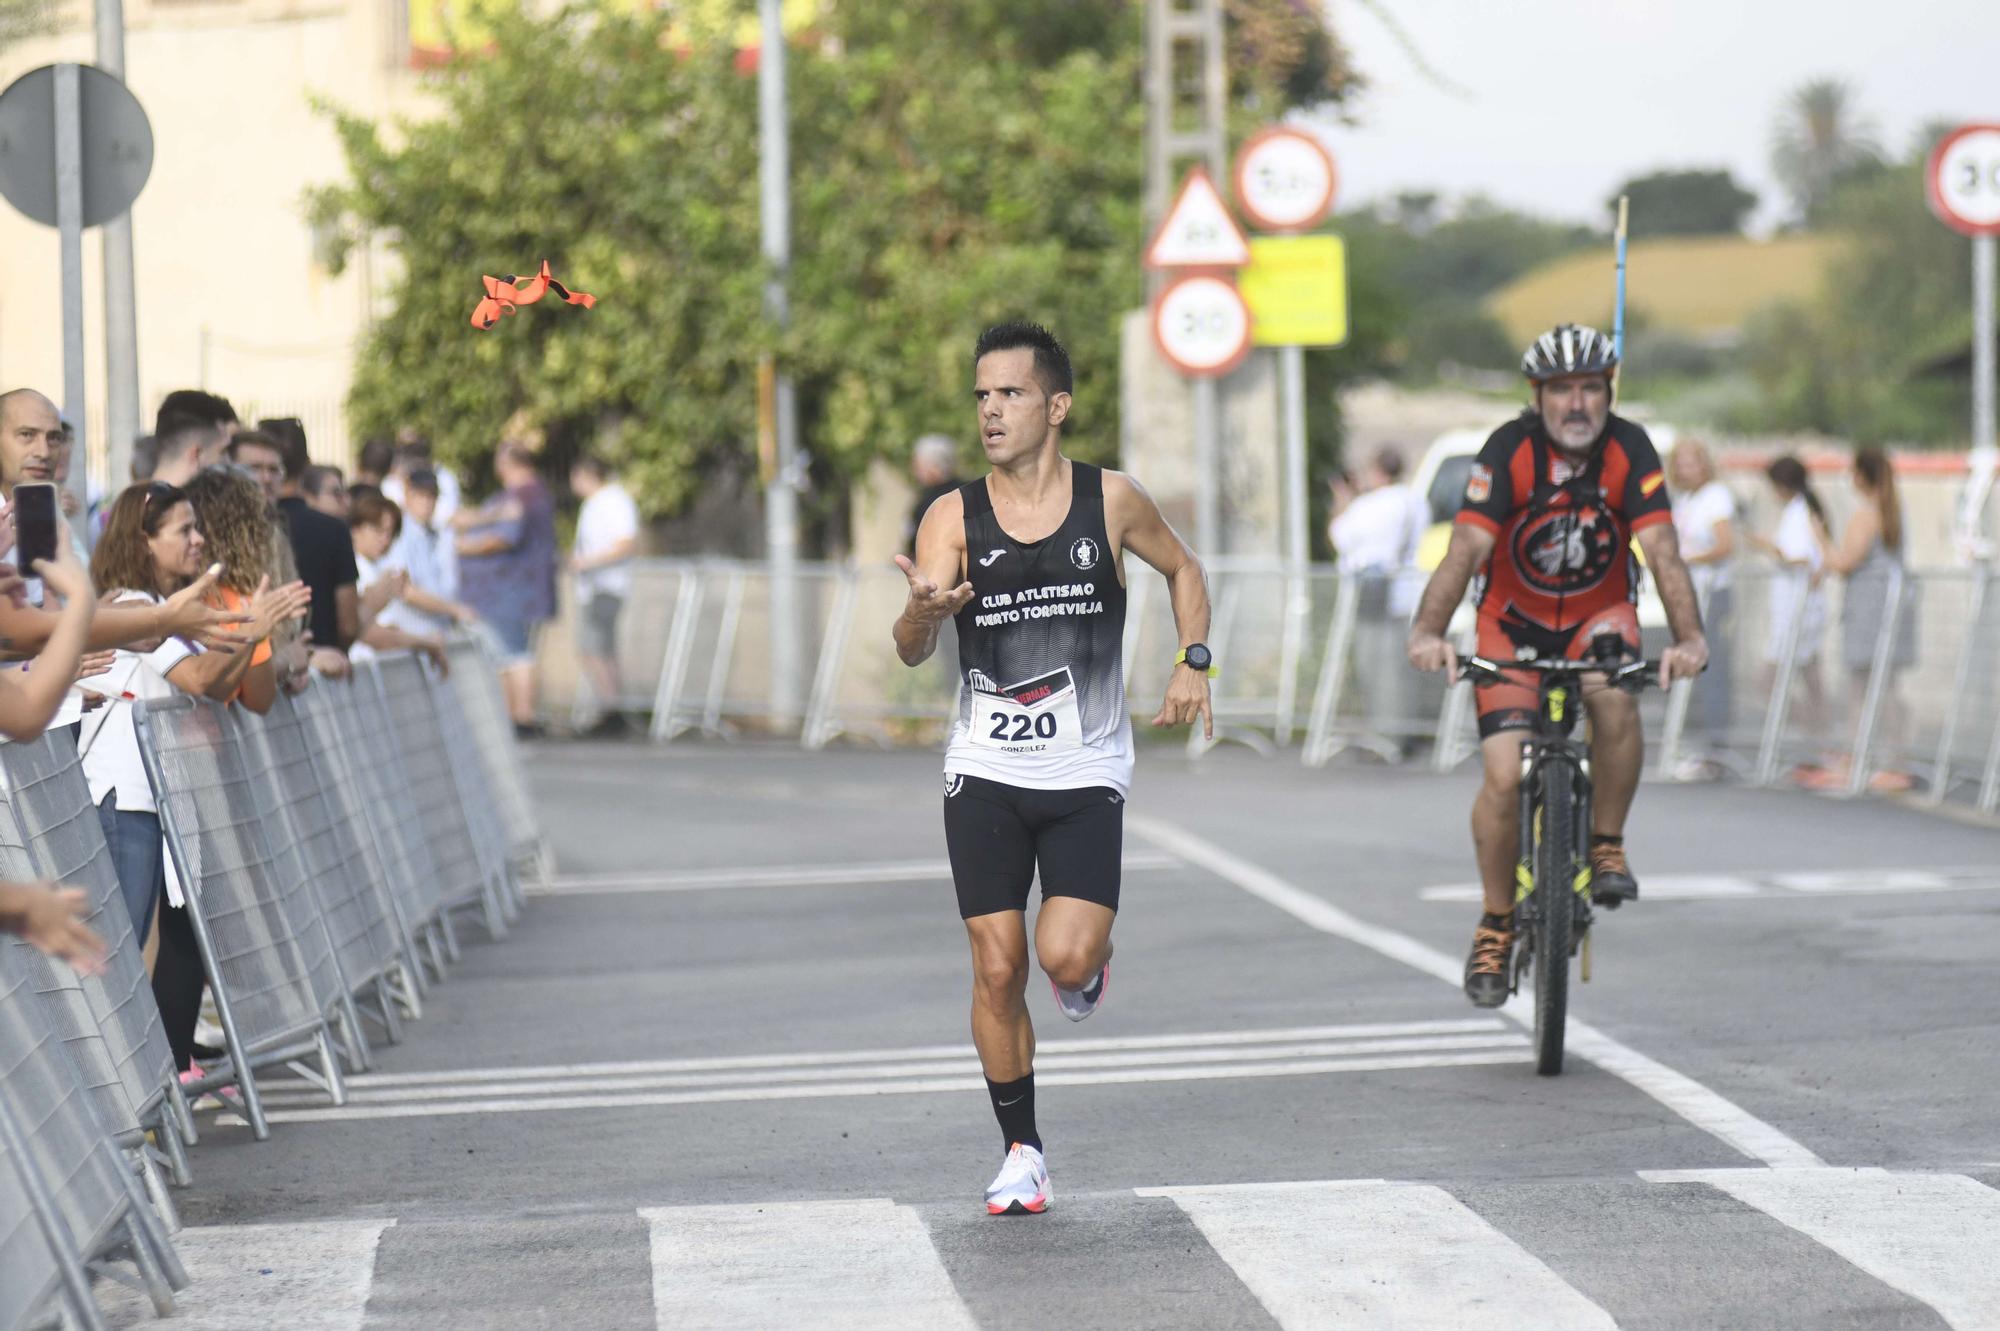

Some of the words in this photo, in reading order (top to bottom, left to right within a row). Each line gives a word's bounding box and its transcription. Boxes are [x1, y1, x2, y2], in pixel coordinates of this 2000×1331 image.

[982, 593, 1012, 608] CLUB
[1016, 582, 1095, 604] ATLETISMO
[975, 609, 1020, 627] PUERTO
[1022, 601, 1103, 620] TORREVIEJA
[989, 711, 1057, 741] 220
